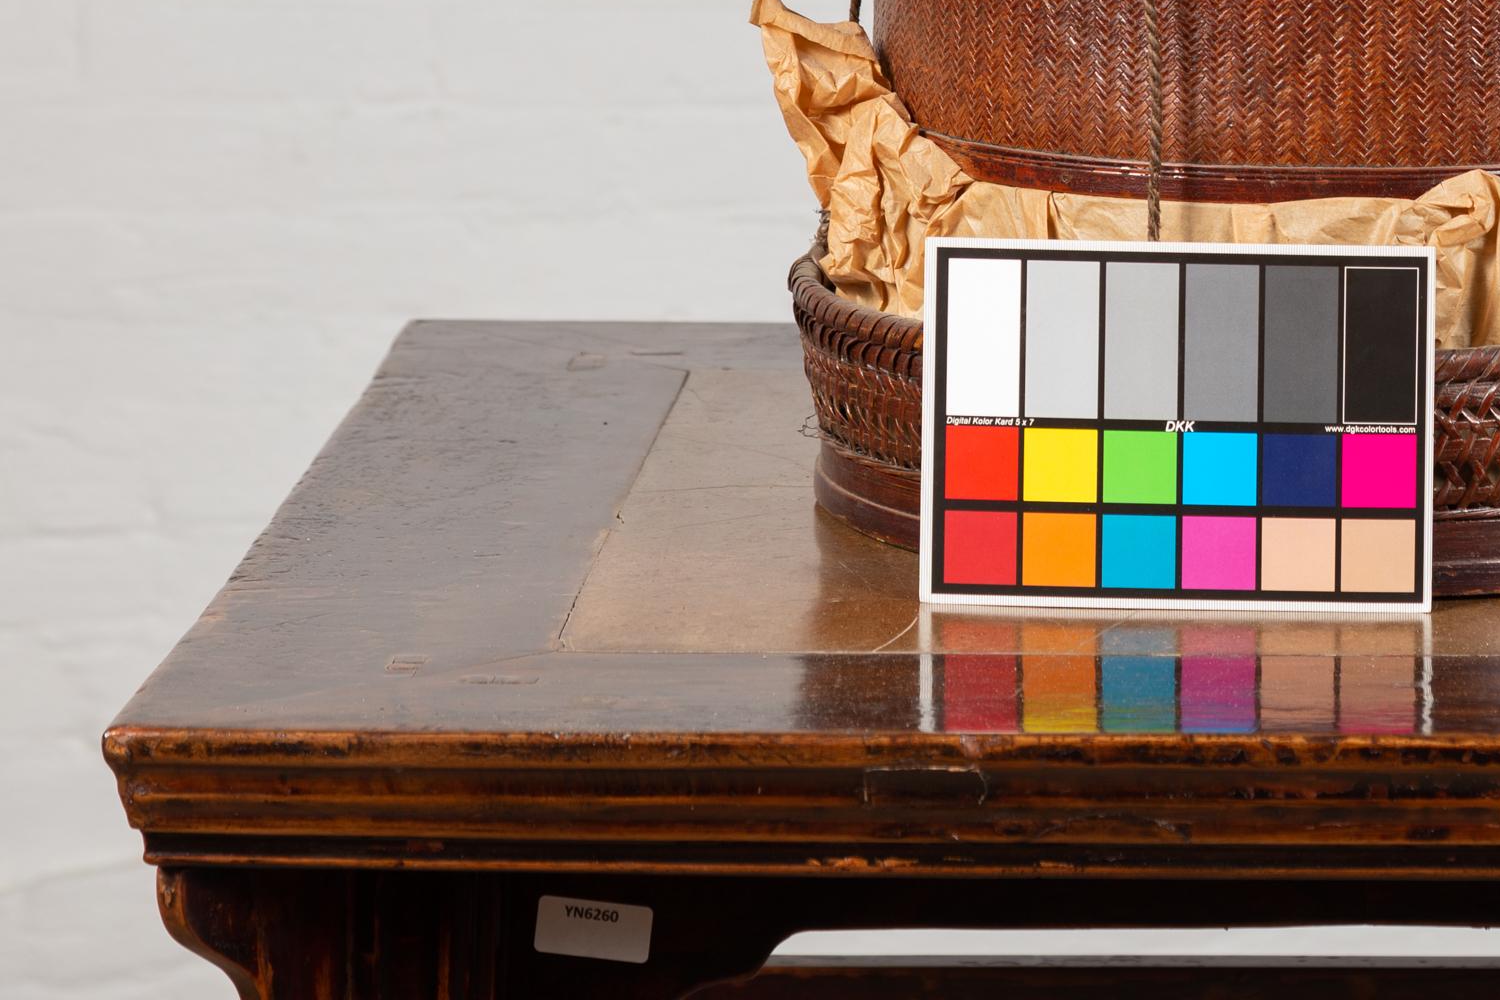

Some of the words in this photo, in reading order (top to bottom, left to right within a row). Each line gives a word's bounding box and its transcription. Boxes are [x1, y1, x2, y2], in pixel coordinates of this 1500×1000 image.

[946, 416, 971, 426] Digital
[972, 417, 993, 425] Kolor
[995, 417, 1014, 426] Kard
[1015, 417, 1020, 426] 5
[1029, 418, 1034, 426] 7
[1165, 420, 1195, 432] DKK
[1325, 425, 1416, 434] www.dgkcolortools.com
[565, 905, 619, 923] YN6260
